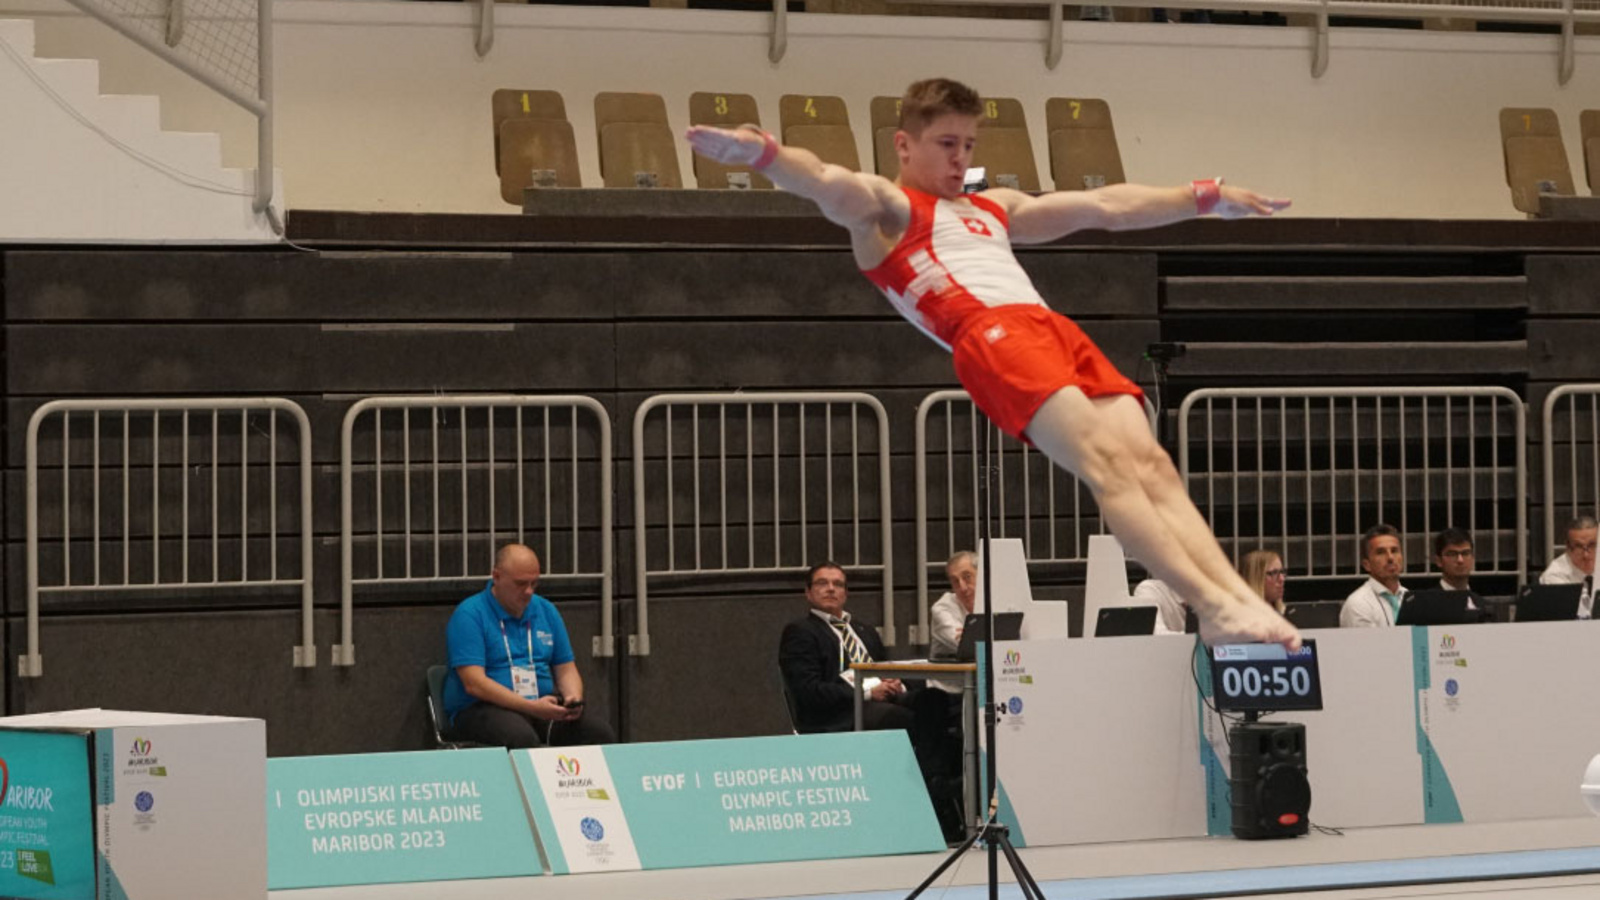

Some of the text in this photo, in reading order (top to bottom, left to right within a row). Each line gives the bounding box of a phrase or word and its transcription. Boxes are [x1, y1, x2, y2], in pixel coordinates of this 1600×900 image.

[520, 93, 531, 113] 1
[715, 96, 729, 115] 3
[804, 98, 817, 117] 4
[986, 101, 998, 118] 6
[1069, 102, 1080, 119] 7
[1223, 666, 1310, 697] 00:50
[642, 773, 685, 791] EYOF
[714, 763, 862, 787] EUROPEAN YOUTH
[297, 781, 481, 807] OLIMPIJSKI FESTIVAL
[721, 785, 870, 810] OLYMPIC FESTIVAL
[305, 804, 483, 830] EVROPSKE MLADINE
[729, 809, 852, 833] MARIBOR 2023
[312, 830, 446, 854] MARIBOR 2023
